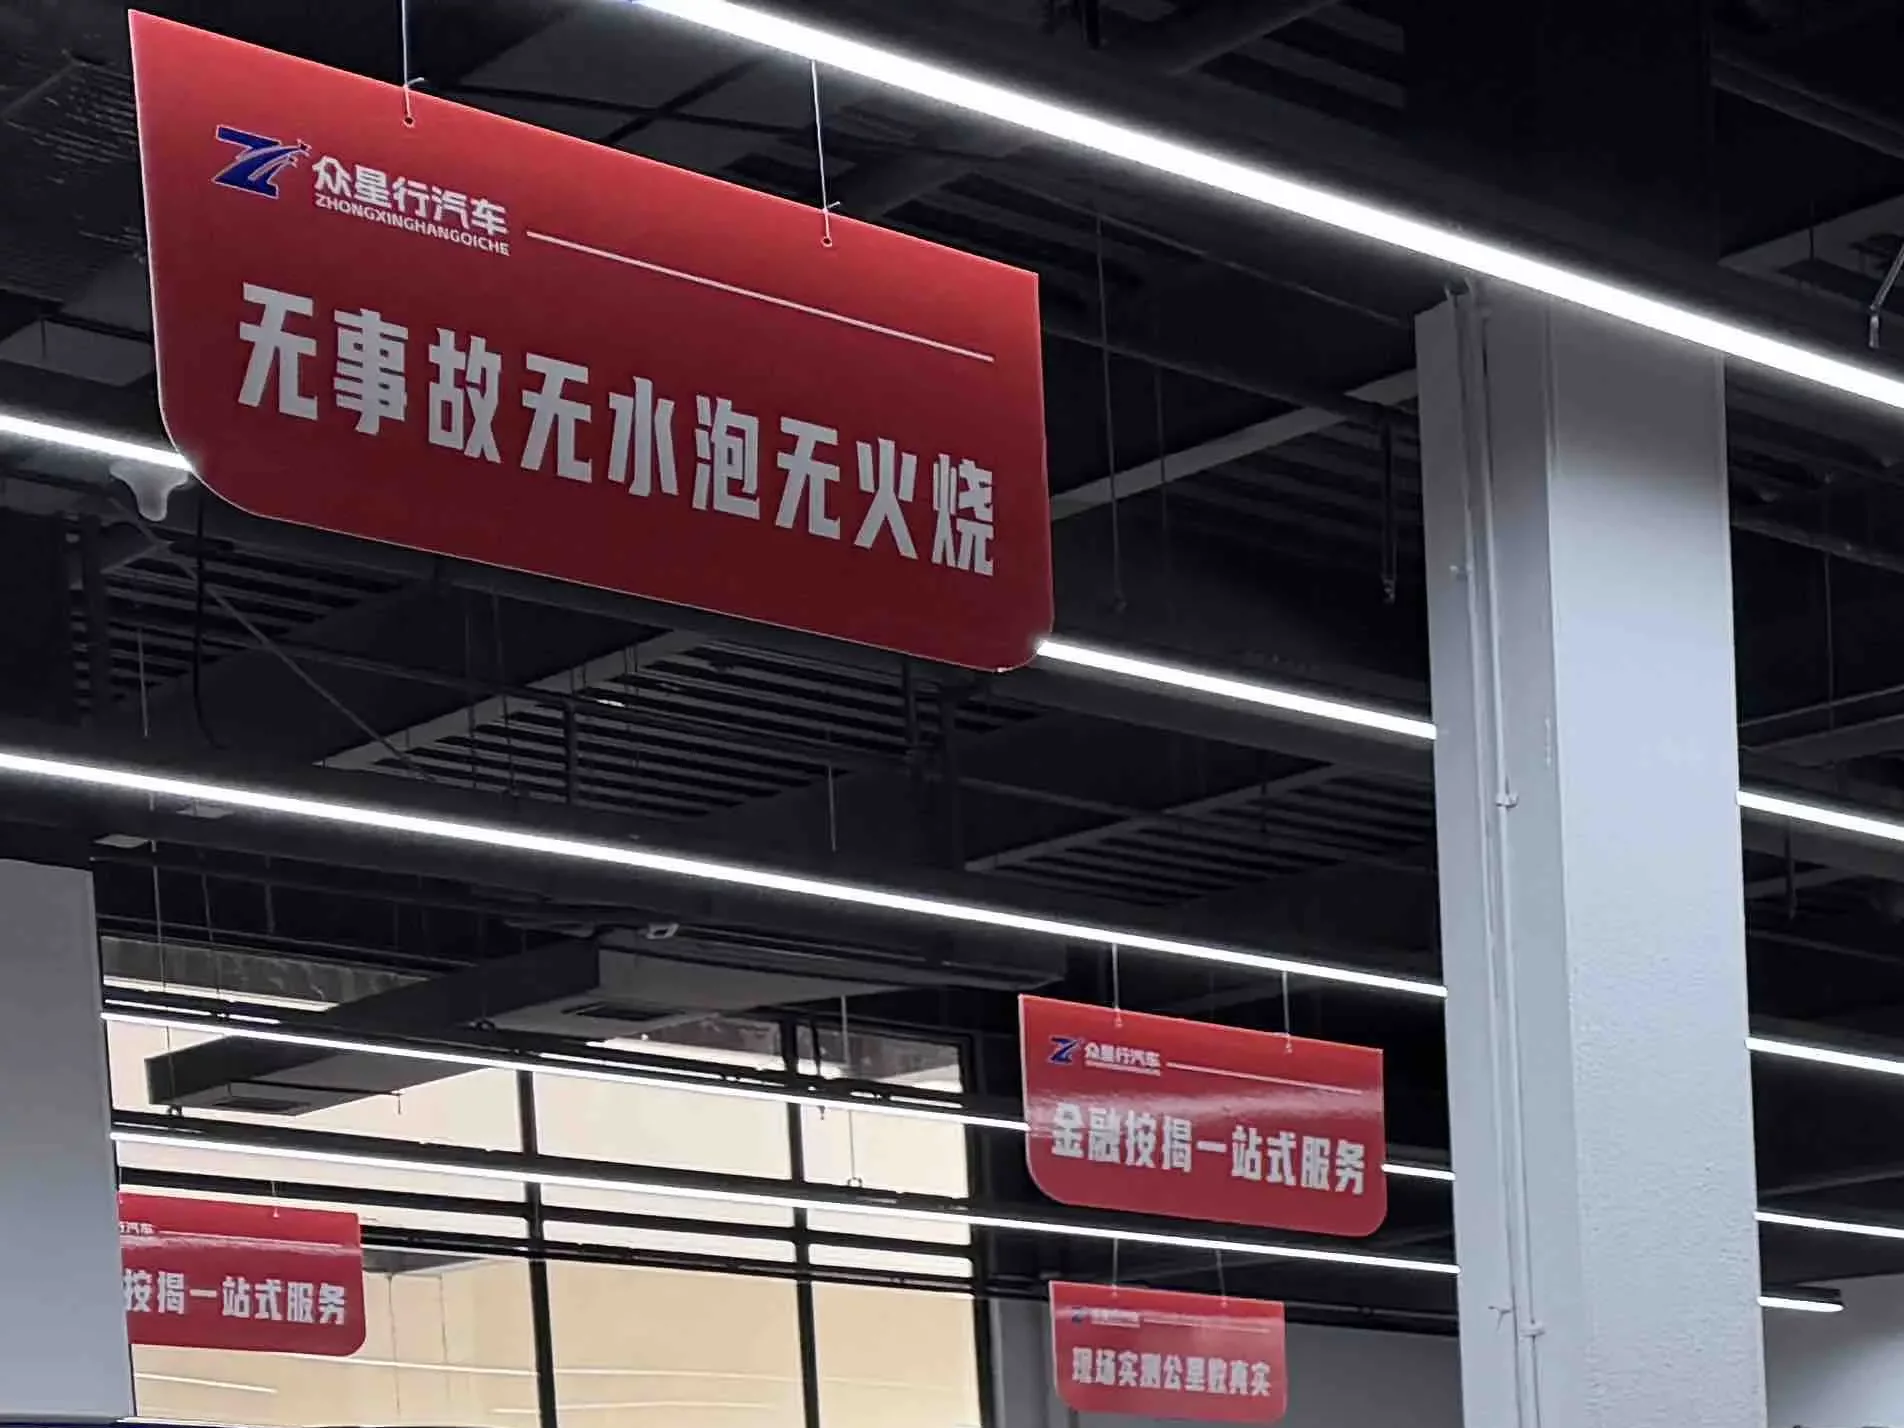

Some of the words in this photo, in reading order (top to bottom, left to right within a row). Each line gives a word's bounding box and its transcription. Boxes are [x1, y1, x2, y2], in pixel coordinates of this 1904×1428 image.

[311, 154, 510, 238] 众星行汽车
[237, 282, 995, 577] 无事故无水泡无火烧
[1050, 1102, 1366, 1195] 金融按揭一站式服务
[121, 1266, 345, 1326] 按揭一站式服务
